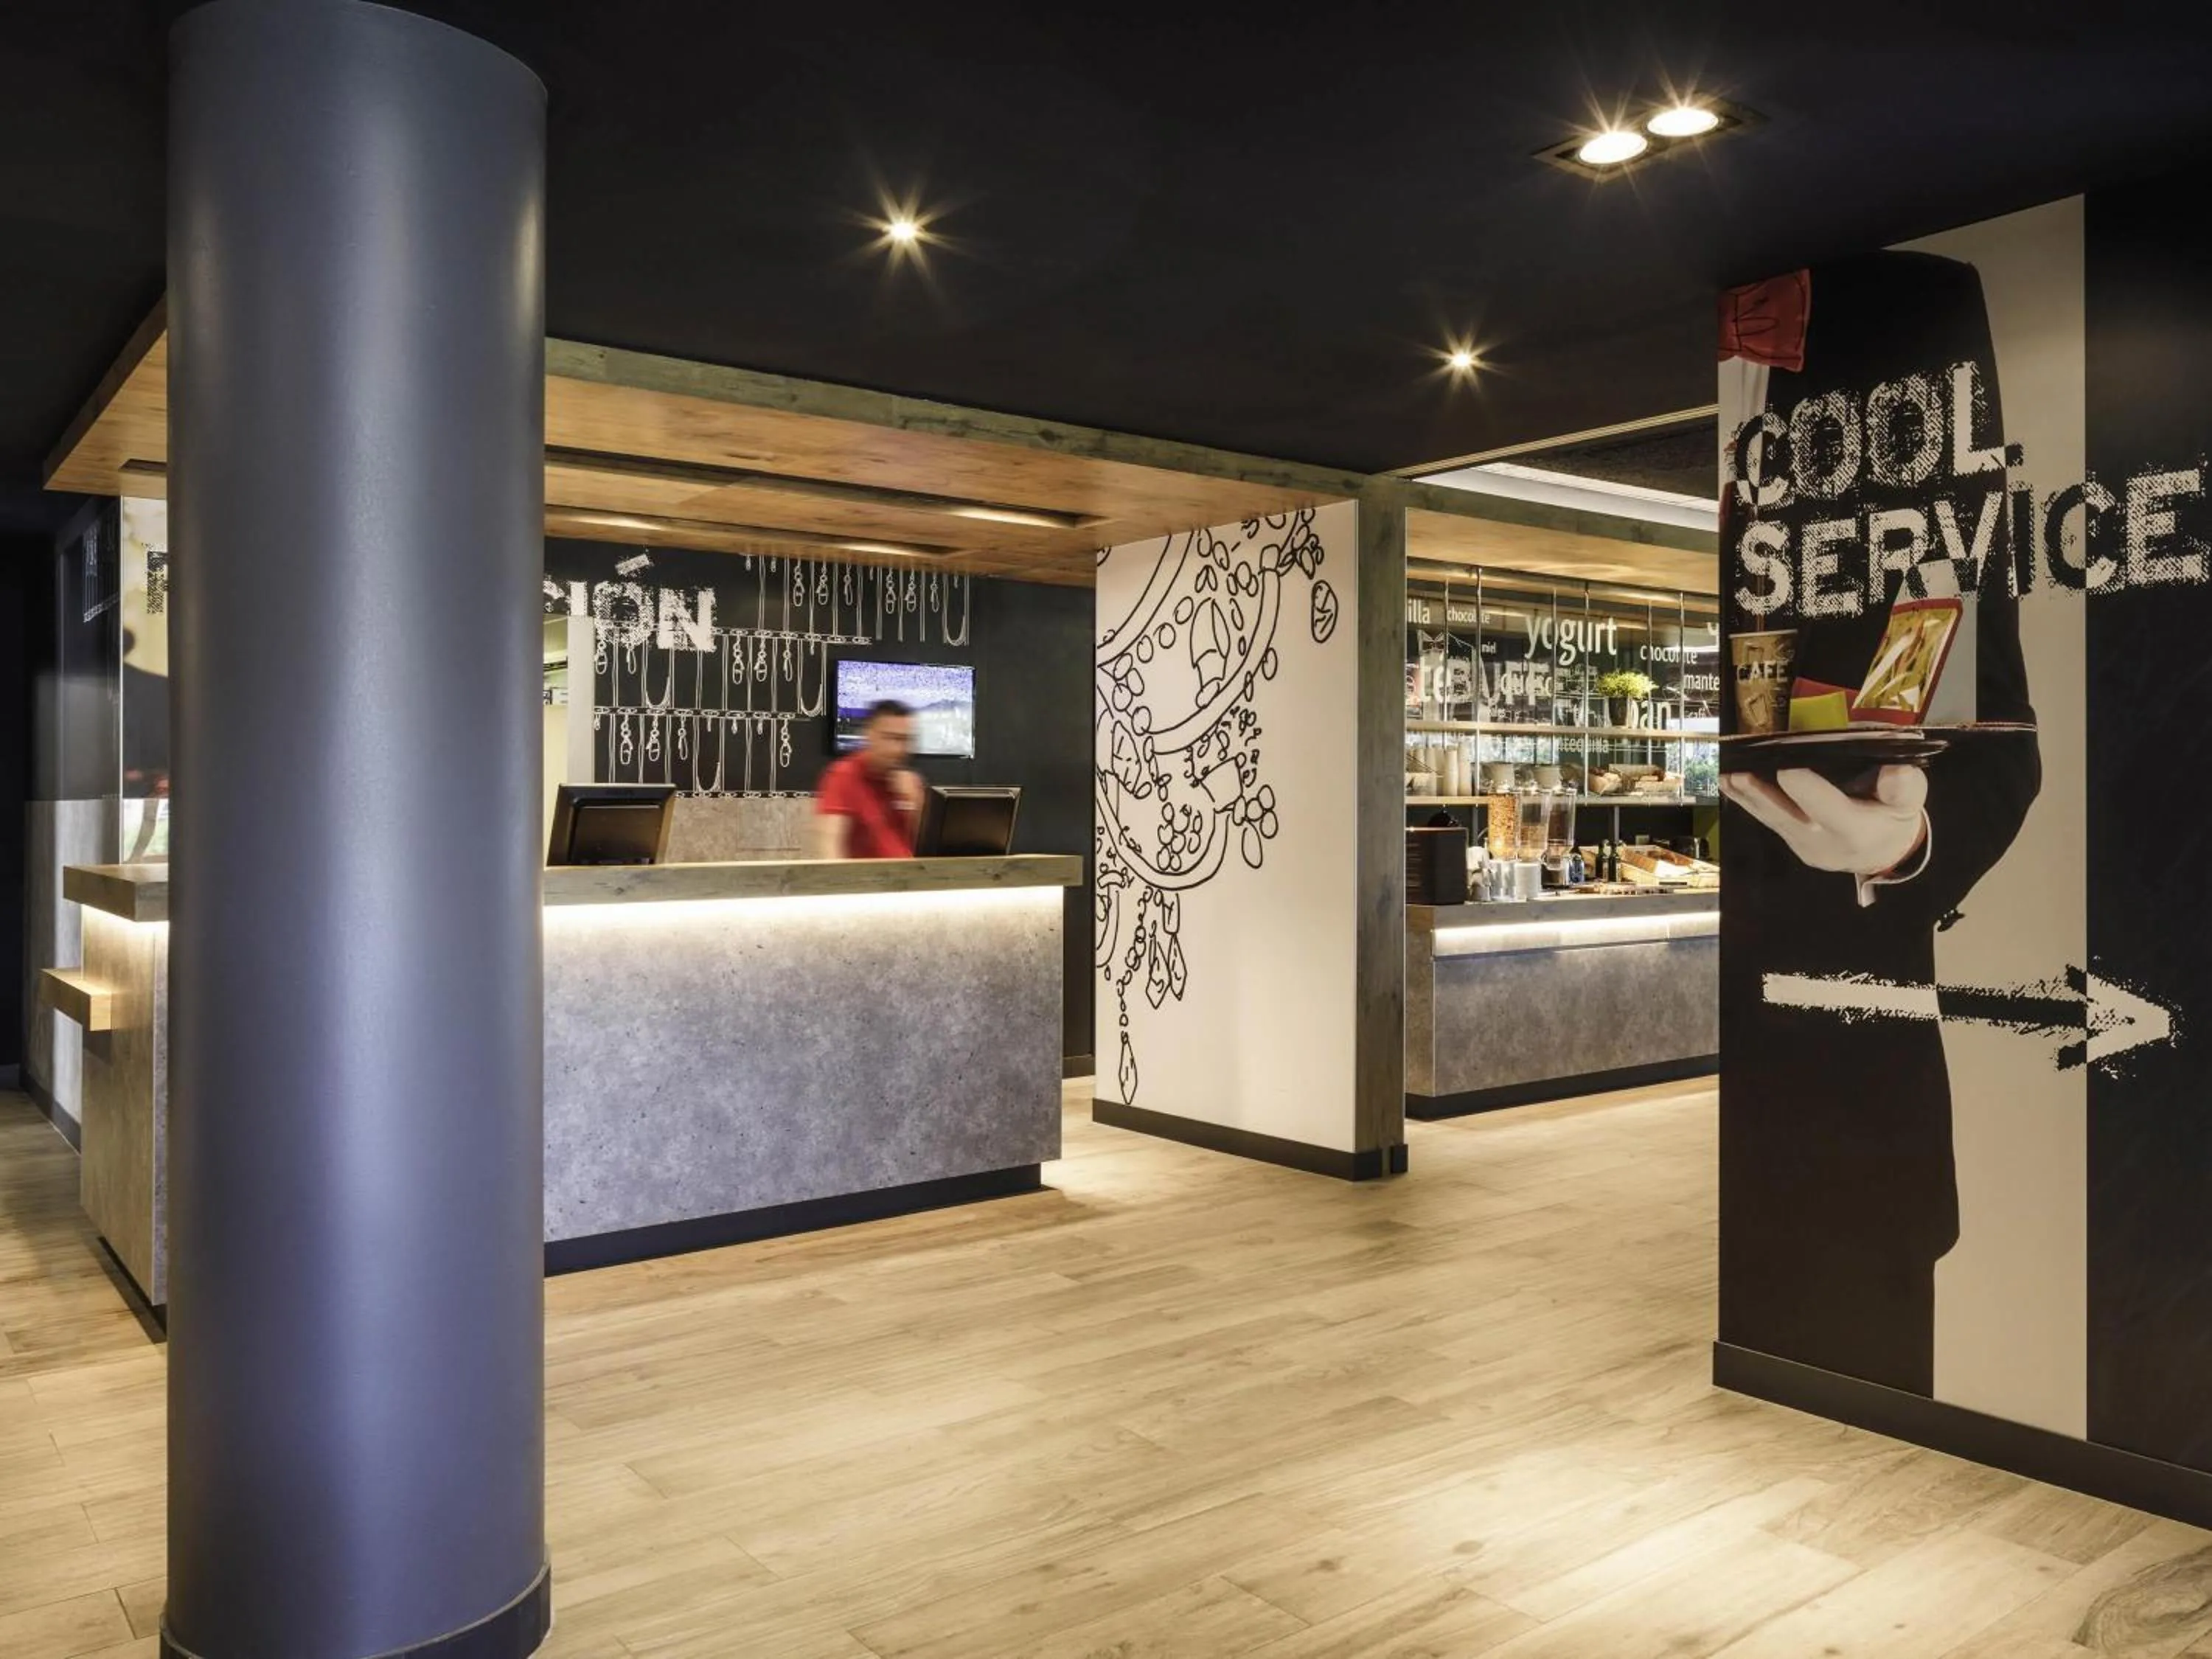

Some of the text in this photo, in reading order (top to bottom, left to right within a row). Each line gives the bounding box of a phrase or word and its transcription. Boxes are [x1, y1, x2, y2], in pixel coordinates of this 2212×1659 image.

[1733, 361, 2023, 510] COOL
[1734, 465, 2211, 619] SERVICE
[1447, 606, 1490, 624] chocolte
[1523, 615, 1617, 666] yogurt
[1640, 644, 1698, 664] cocolte
